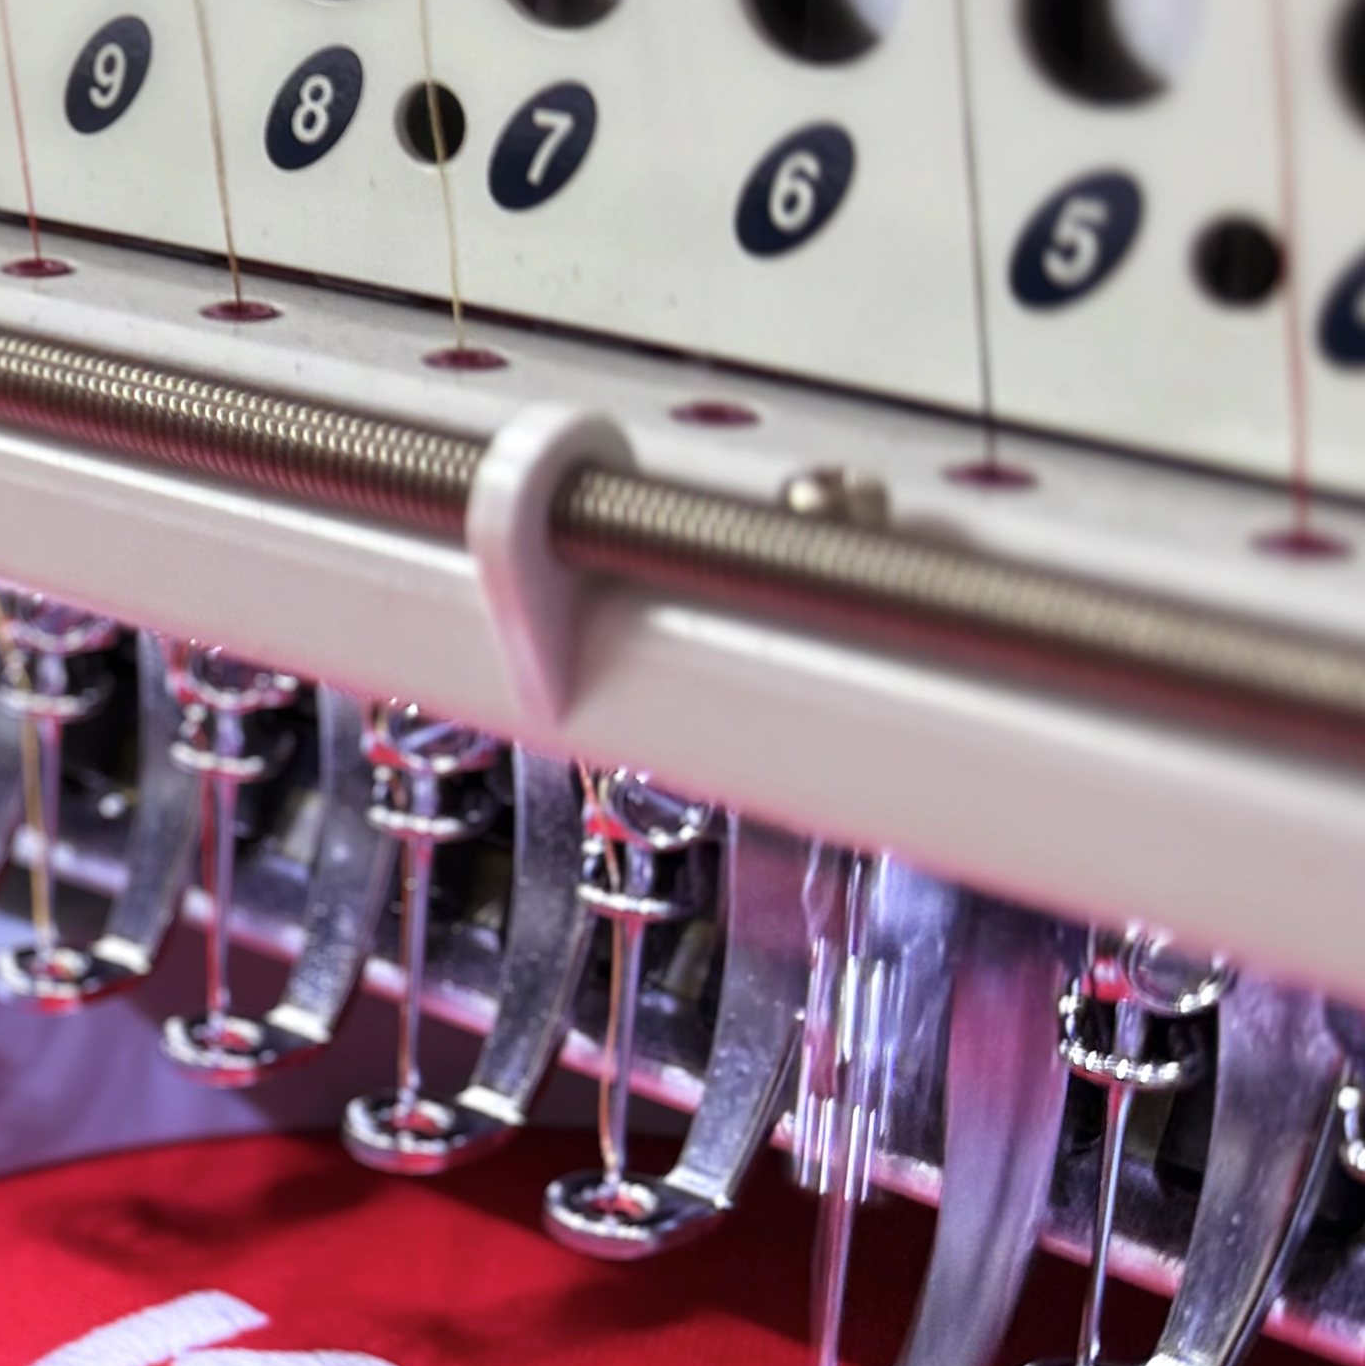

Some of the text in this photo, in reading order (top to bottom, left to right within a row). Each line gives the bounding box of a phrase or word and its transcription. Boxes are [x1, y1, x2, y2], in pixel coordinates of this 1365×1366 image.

[87, 41, 128, 110] 9
[290, 73, 335, 145] 8
[525, 106, 575, 188] 7
[768, 148, 823, 233] 6
[1040, 193, 1110, 290] 5
